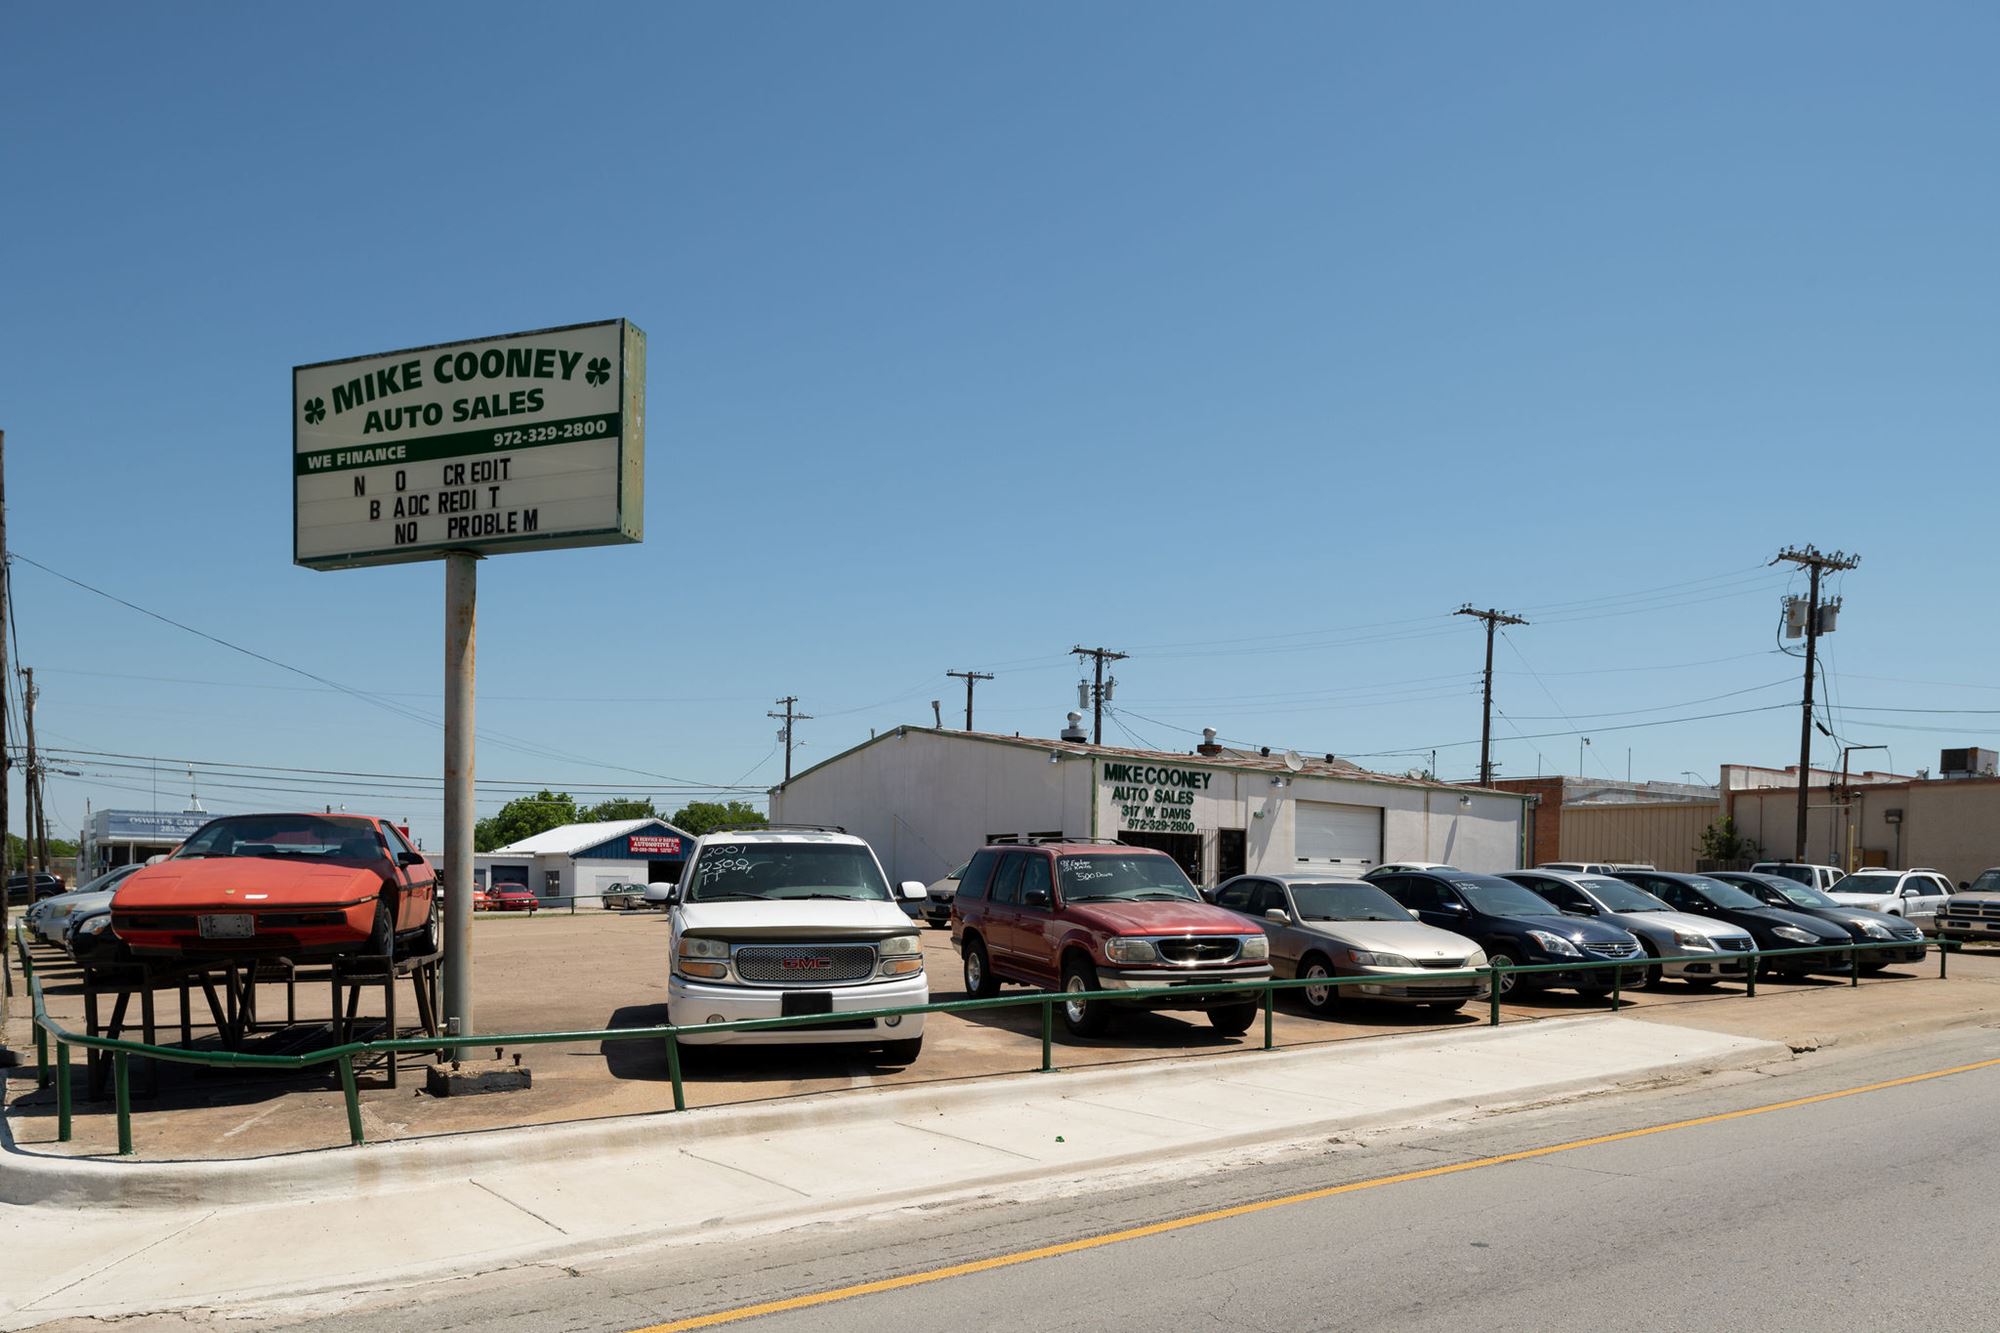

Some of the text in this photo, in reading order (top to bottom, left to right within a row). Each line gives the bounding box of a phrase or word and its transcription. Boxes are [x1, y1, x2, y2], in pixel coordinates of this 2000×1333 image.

[332, 348, 584, 414] MIKE COONEY
[363, 388, 545, 434] AUTO SALES
[493, 420, 608, 447] 972-329-2800
[307, 445, 407, 470] WE FINANCE
[395, 508, 538, 545] NO PROBLEM
[1104, 763, 1212, 790] MIKE COONEY
[1112, 786, 1194, 805] AUTO SALES
[176, 818, 195, 826] CAR
[1122, 804, 1191, 820] 317 W. DAVIS
[1127, 819, 1195, 833] 972-329-2800
[702, 846, 746, 859] 2001
[783, 957, 831, 970] GMC
